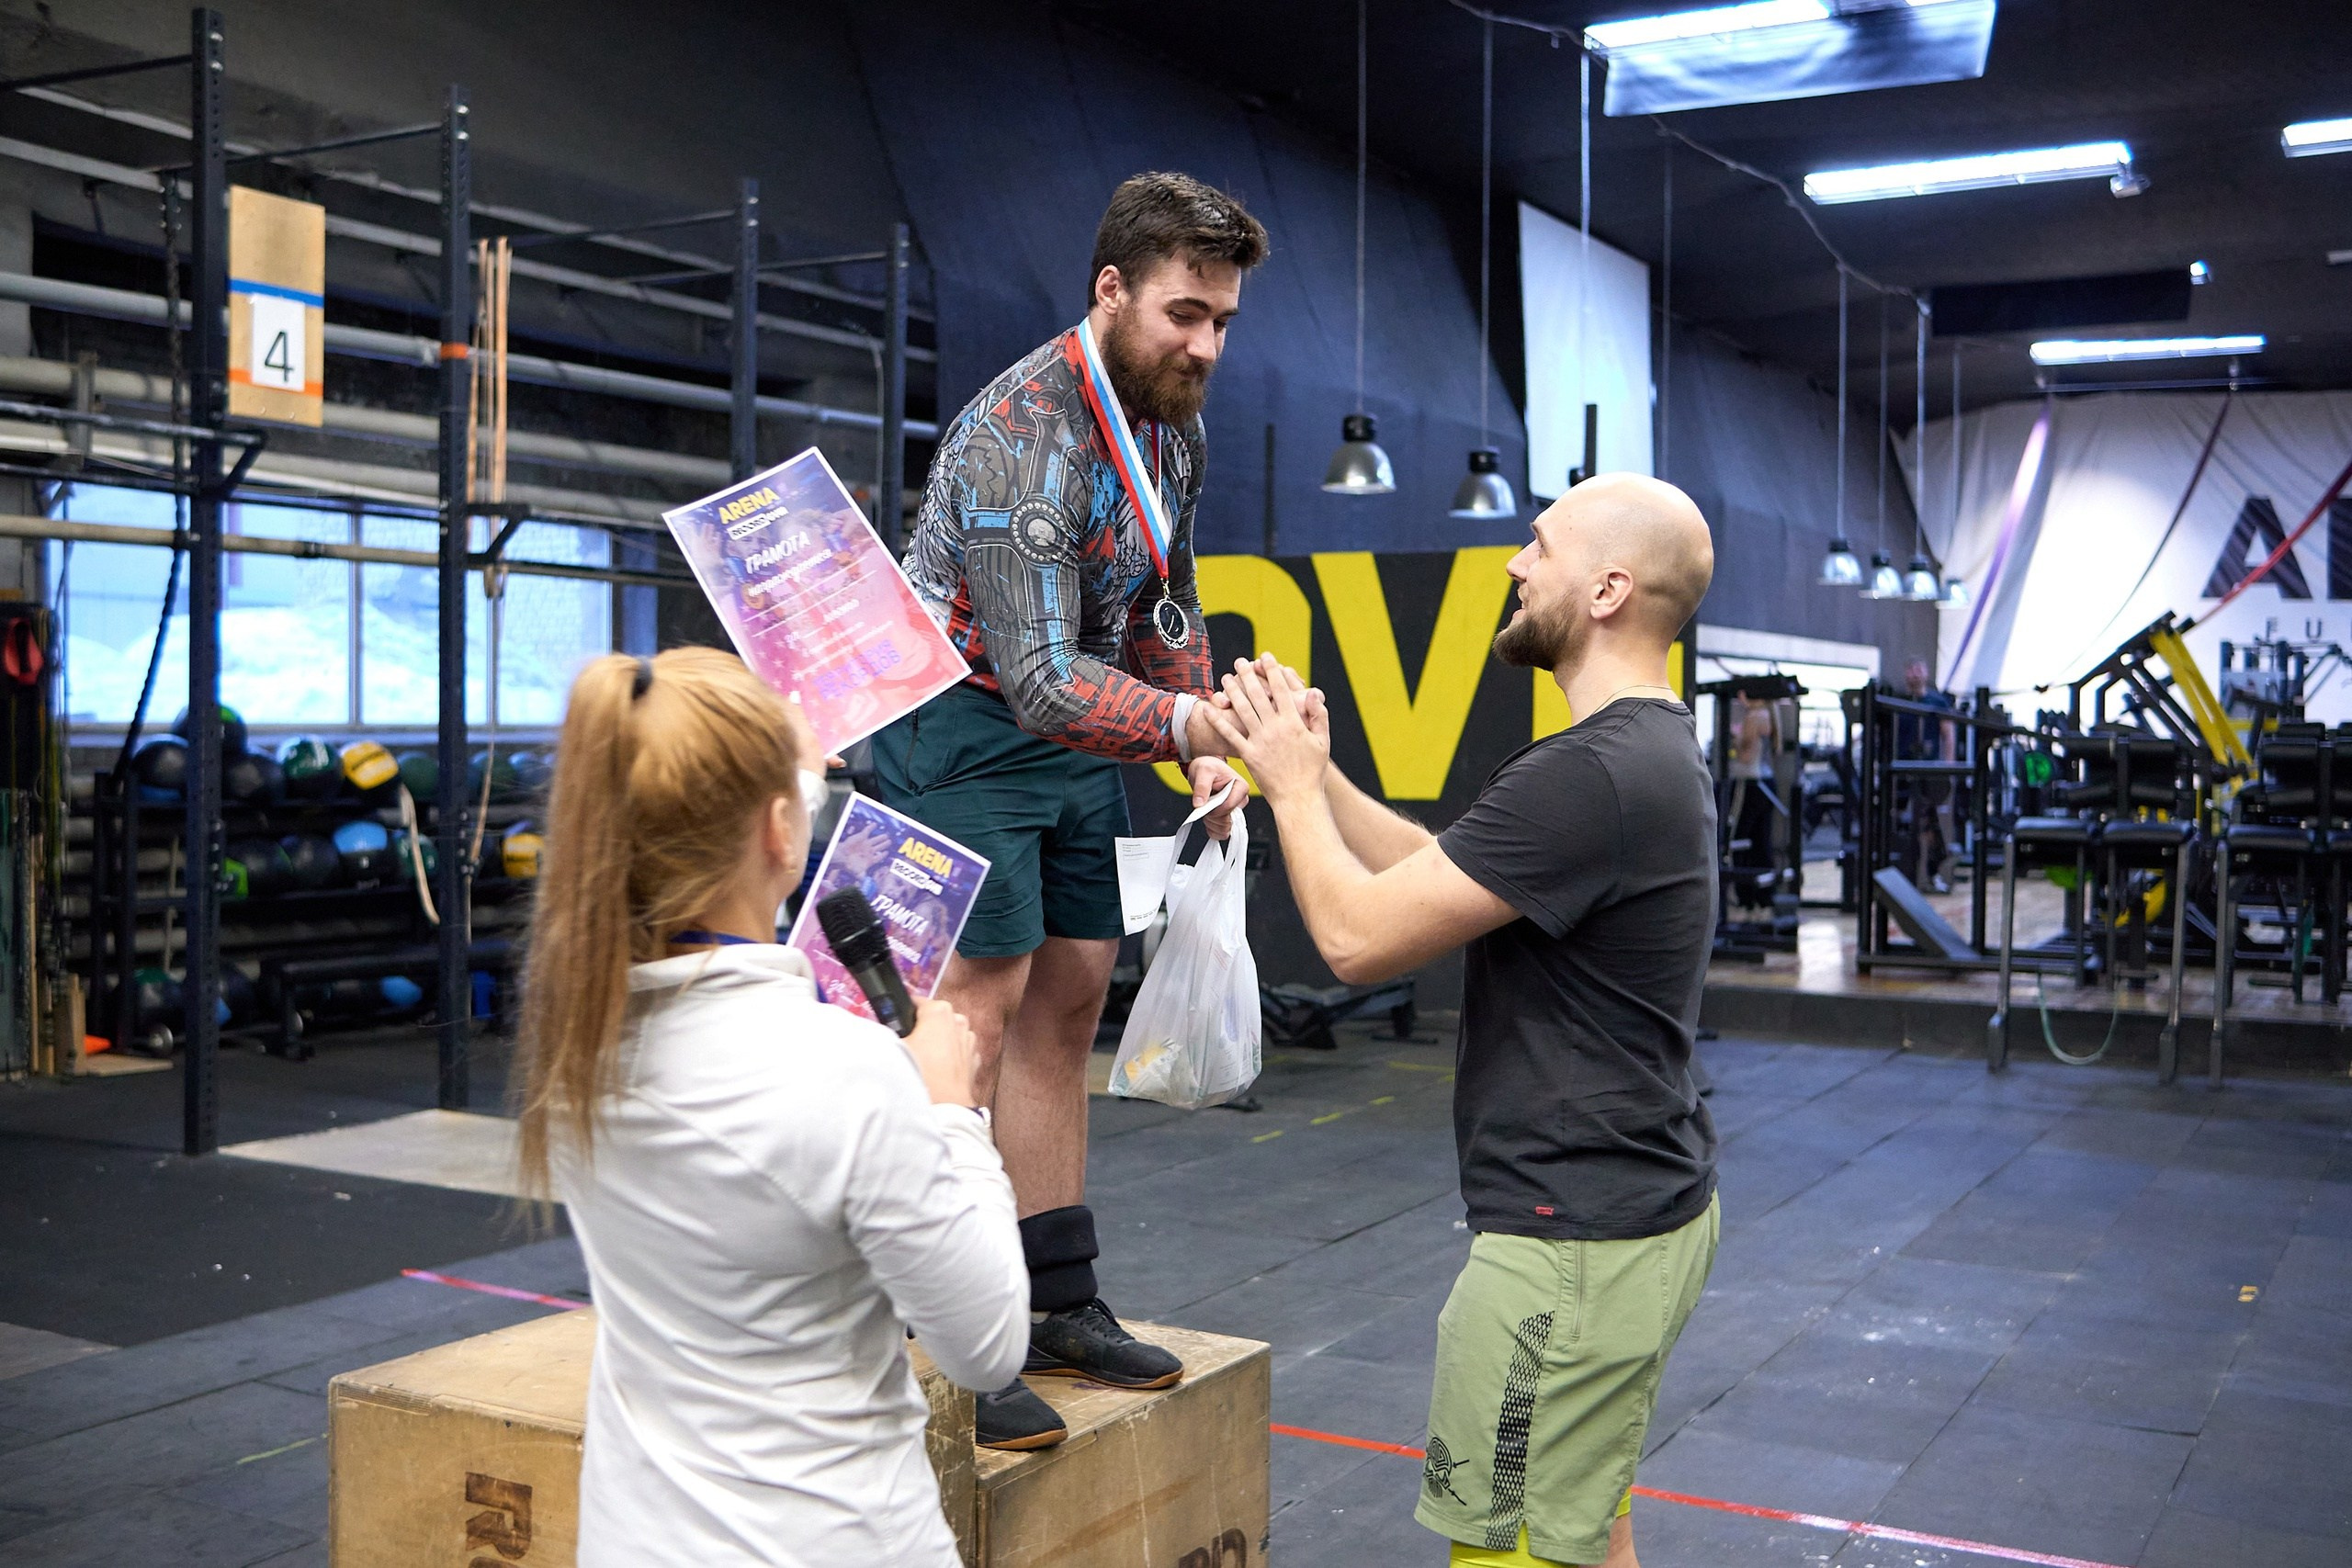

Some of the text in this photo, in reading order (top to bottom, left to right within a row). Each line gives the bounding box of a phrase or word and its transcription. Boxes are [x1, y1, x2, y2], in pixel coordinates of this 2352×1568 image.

[265, 331, 294, 383] 4
[718, 487, 780, 525] ARENA
[745, 531, 811, 574] ГРАМОТА
[898, 837, 953, 878] ARENA
[870, 894, 929, 936] ГРАМОТА
[465, 1472, 533, 1568] R
